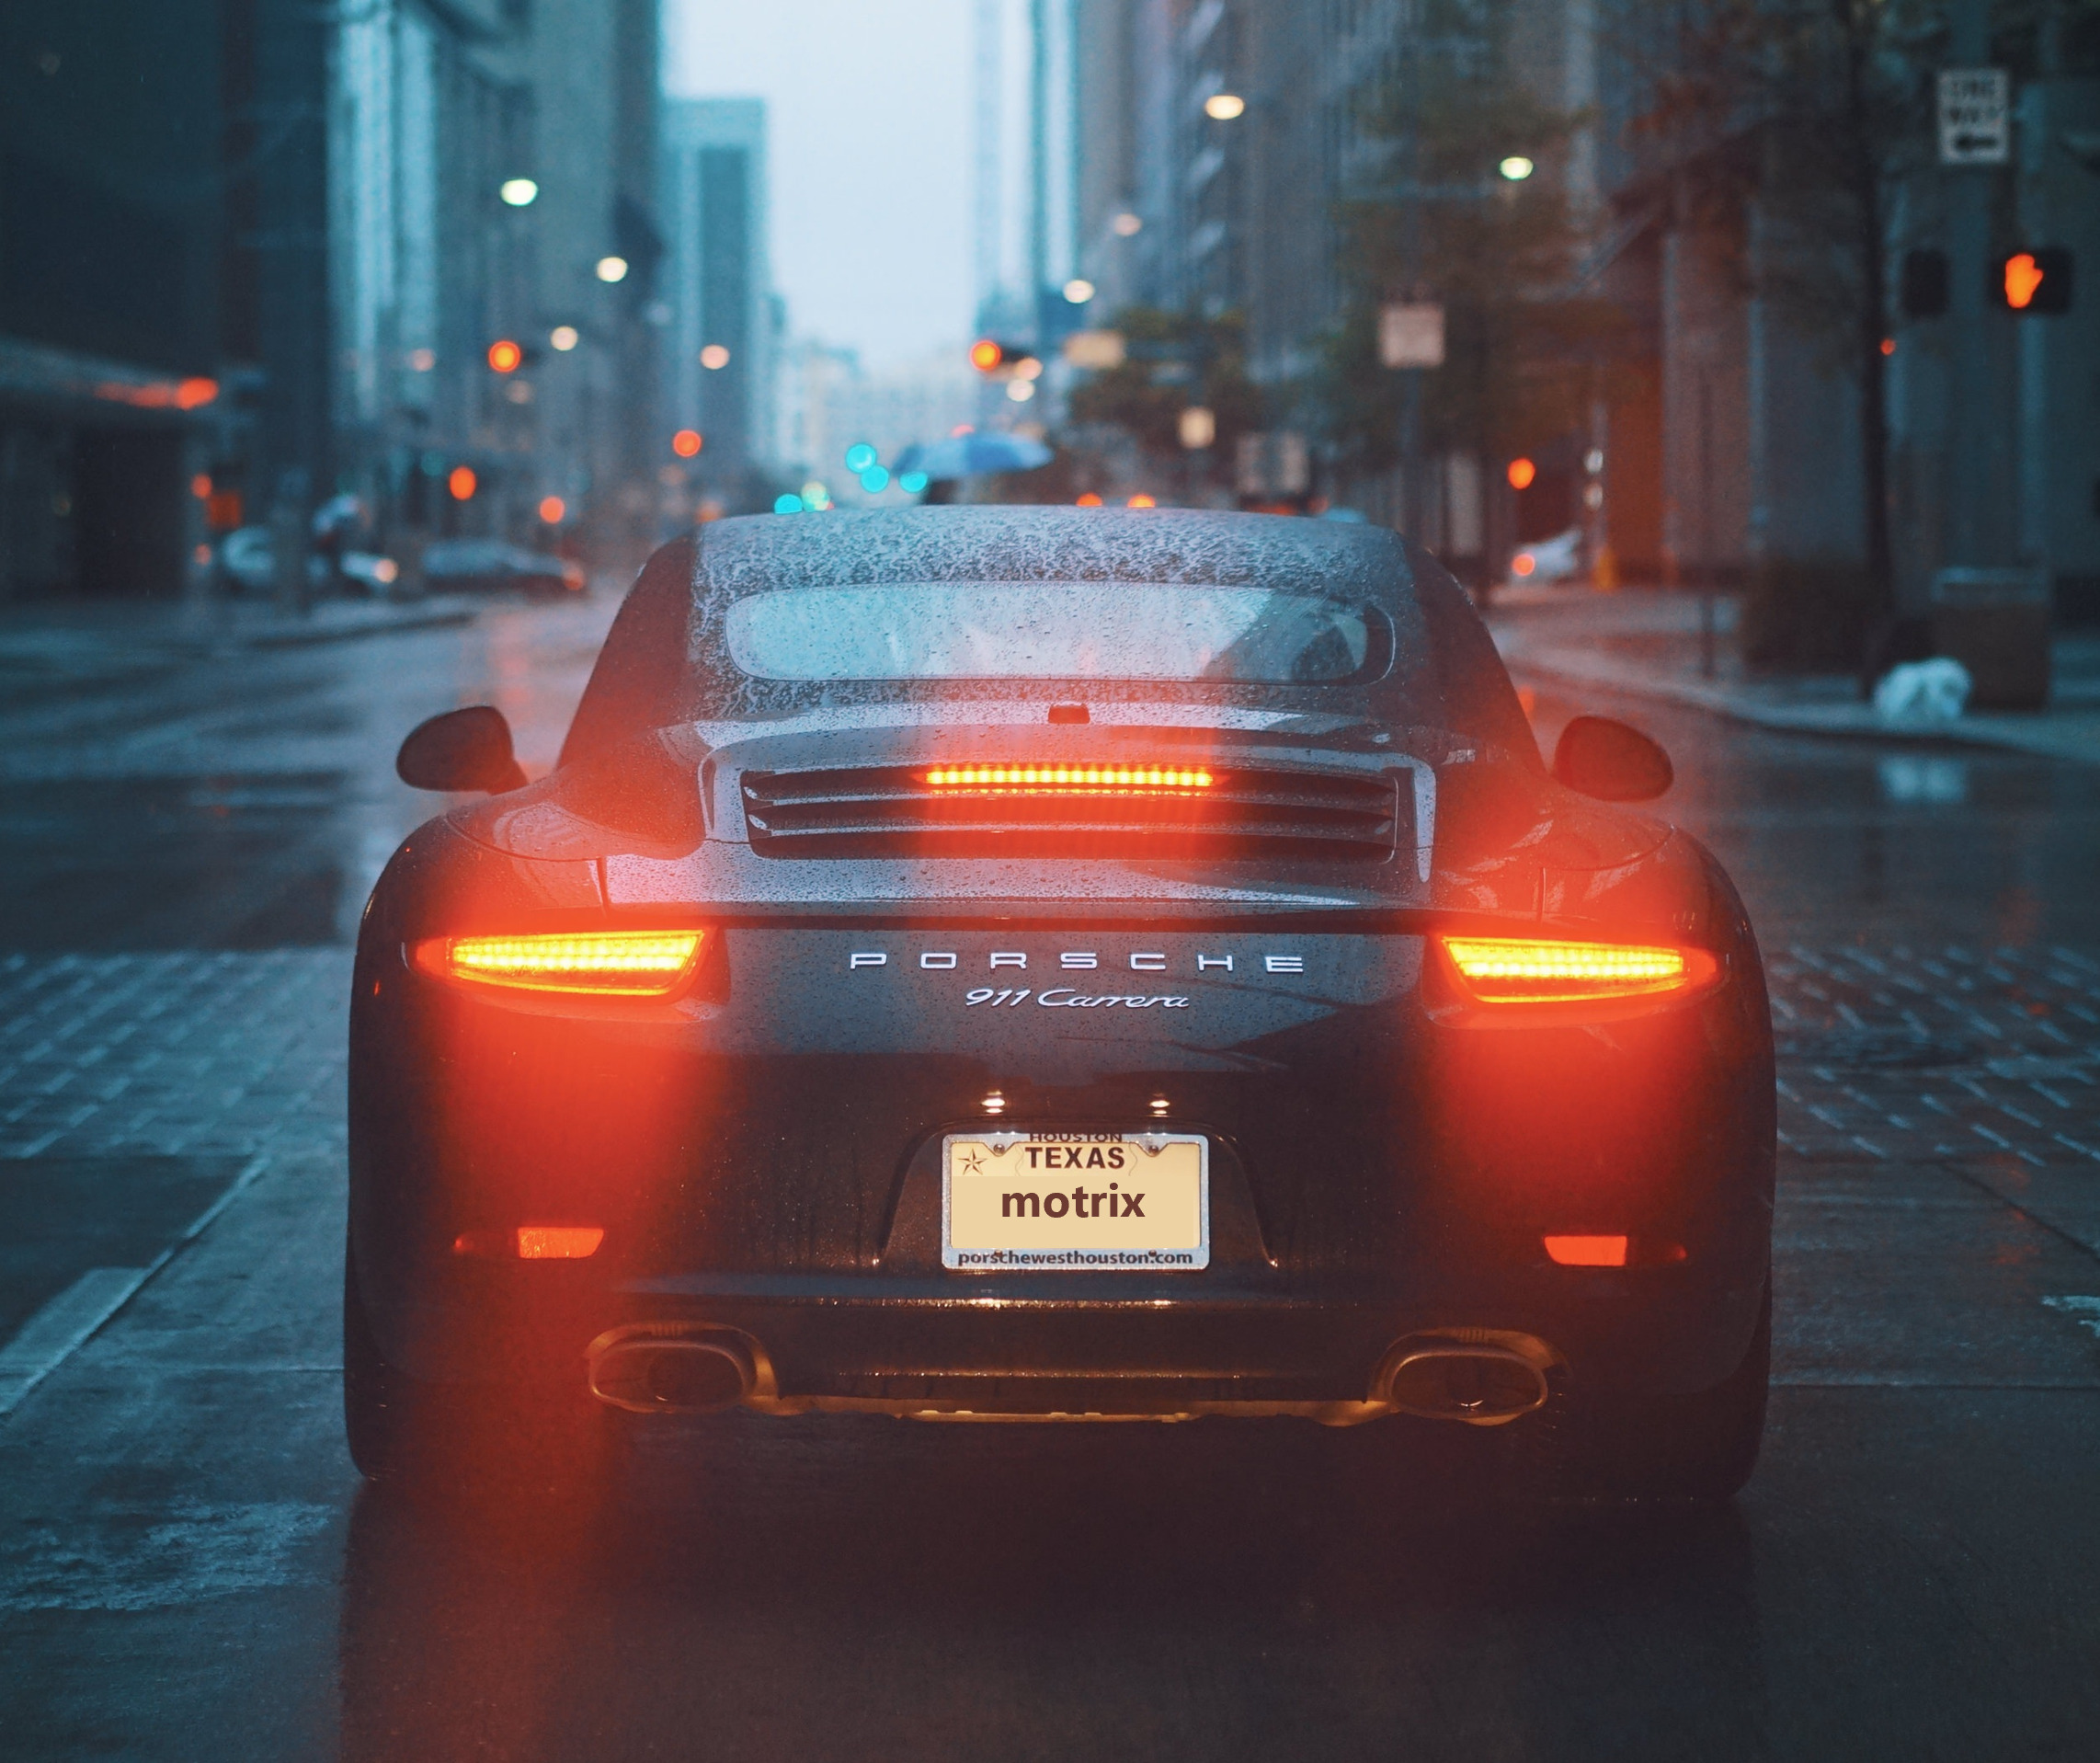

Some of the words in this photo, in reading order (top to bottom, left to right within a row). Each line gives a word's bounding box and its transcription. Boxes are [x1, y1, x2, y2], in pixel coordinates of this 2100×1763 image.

[850, 952, 1304, 973] PORSCHE
[964, 989, 1031, 1007] 911
[1036, 989, 1191, 1009] Carrera
[1030, 1133, 1123, 1143] HOUSTON
[1024, 1147, 1125, 1169] TEXAS
[1002, 1183, 1146, 1218] motrix
[958, 1251, 1193, 1266] porschewesthouston.com
